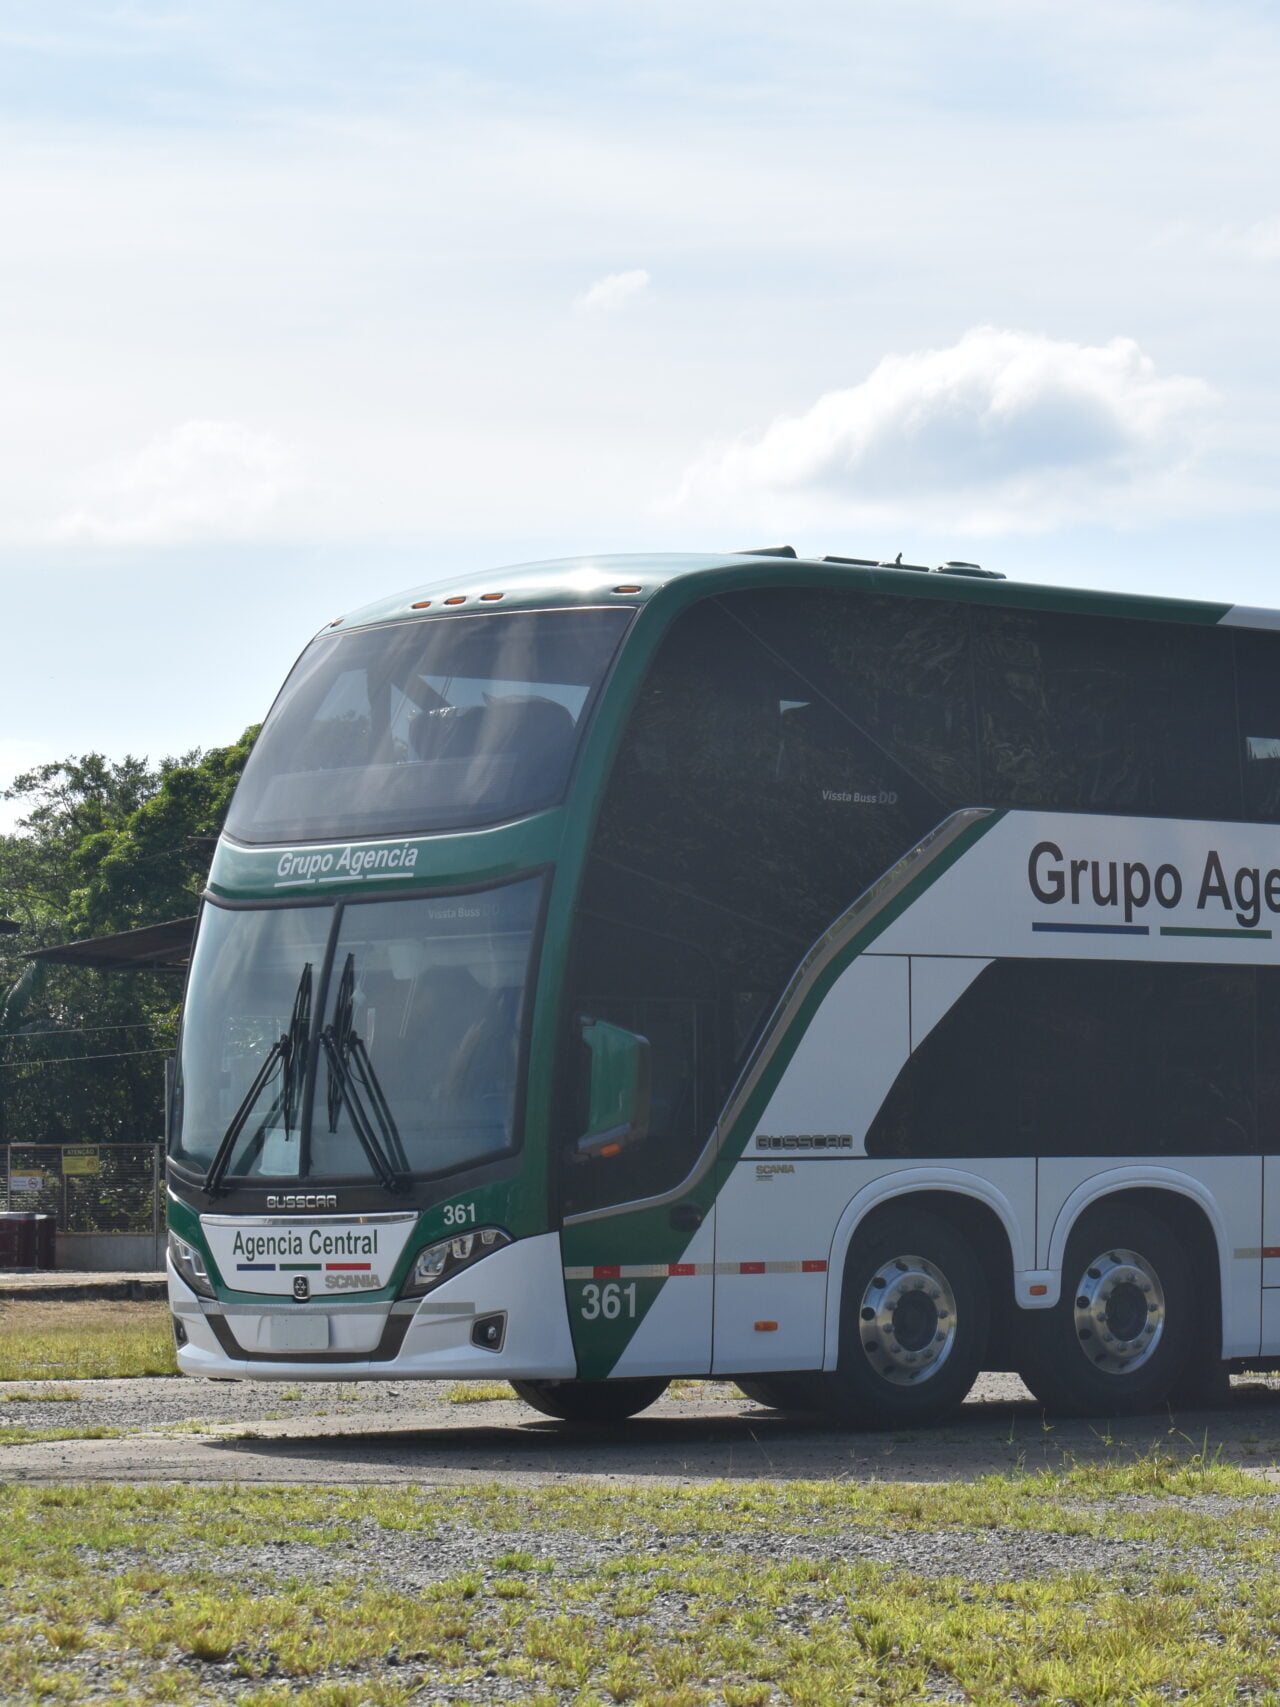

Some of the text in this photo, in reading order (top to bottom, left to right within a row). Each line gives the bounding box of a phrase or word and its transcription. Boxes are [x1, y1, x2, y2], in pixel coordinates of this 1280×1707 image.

[822, 789, 852, 802] Vissta
[853, 792, 877, 804] Buss
[277, 842, 418, 878] Grupo Agencia
[1028, 841, 1183, 923] Grupo
[457, 907, 481, 918] Buss
[755, 1135, 853, 1150] BUSSCAR
[756, 1164, 795, 1175] SCANIA
[266, 1194, 337, 1209] BUSSCAR
[443, 1203, 477, 1226] 361
[233, 1229, 378, 1262] Agencia Central
[324, 1275, 381, 1289] SCANIA
[580, 1283, 637, 1321] 361
